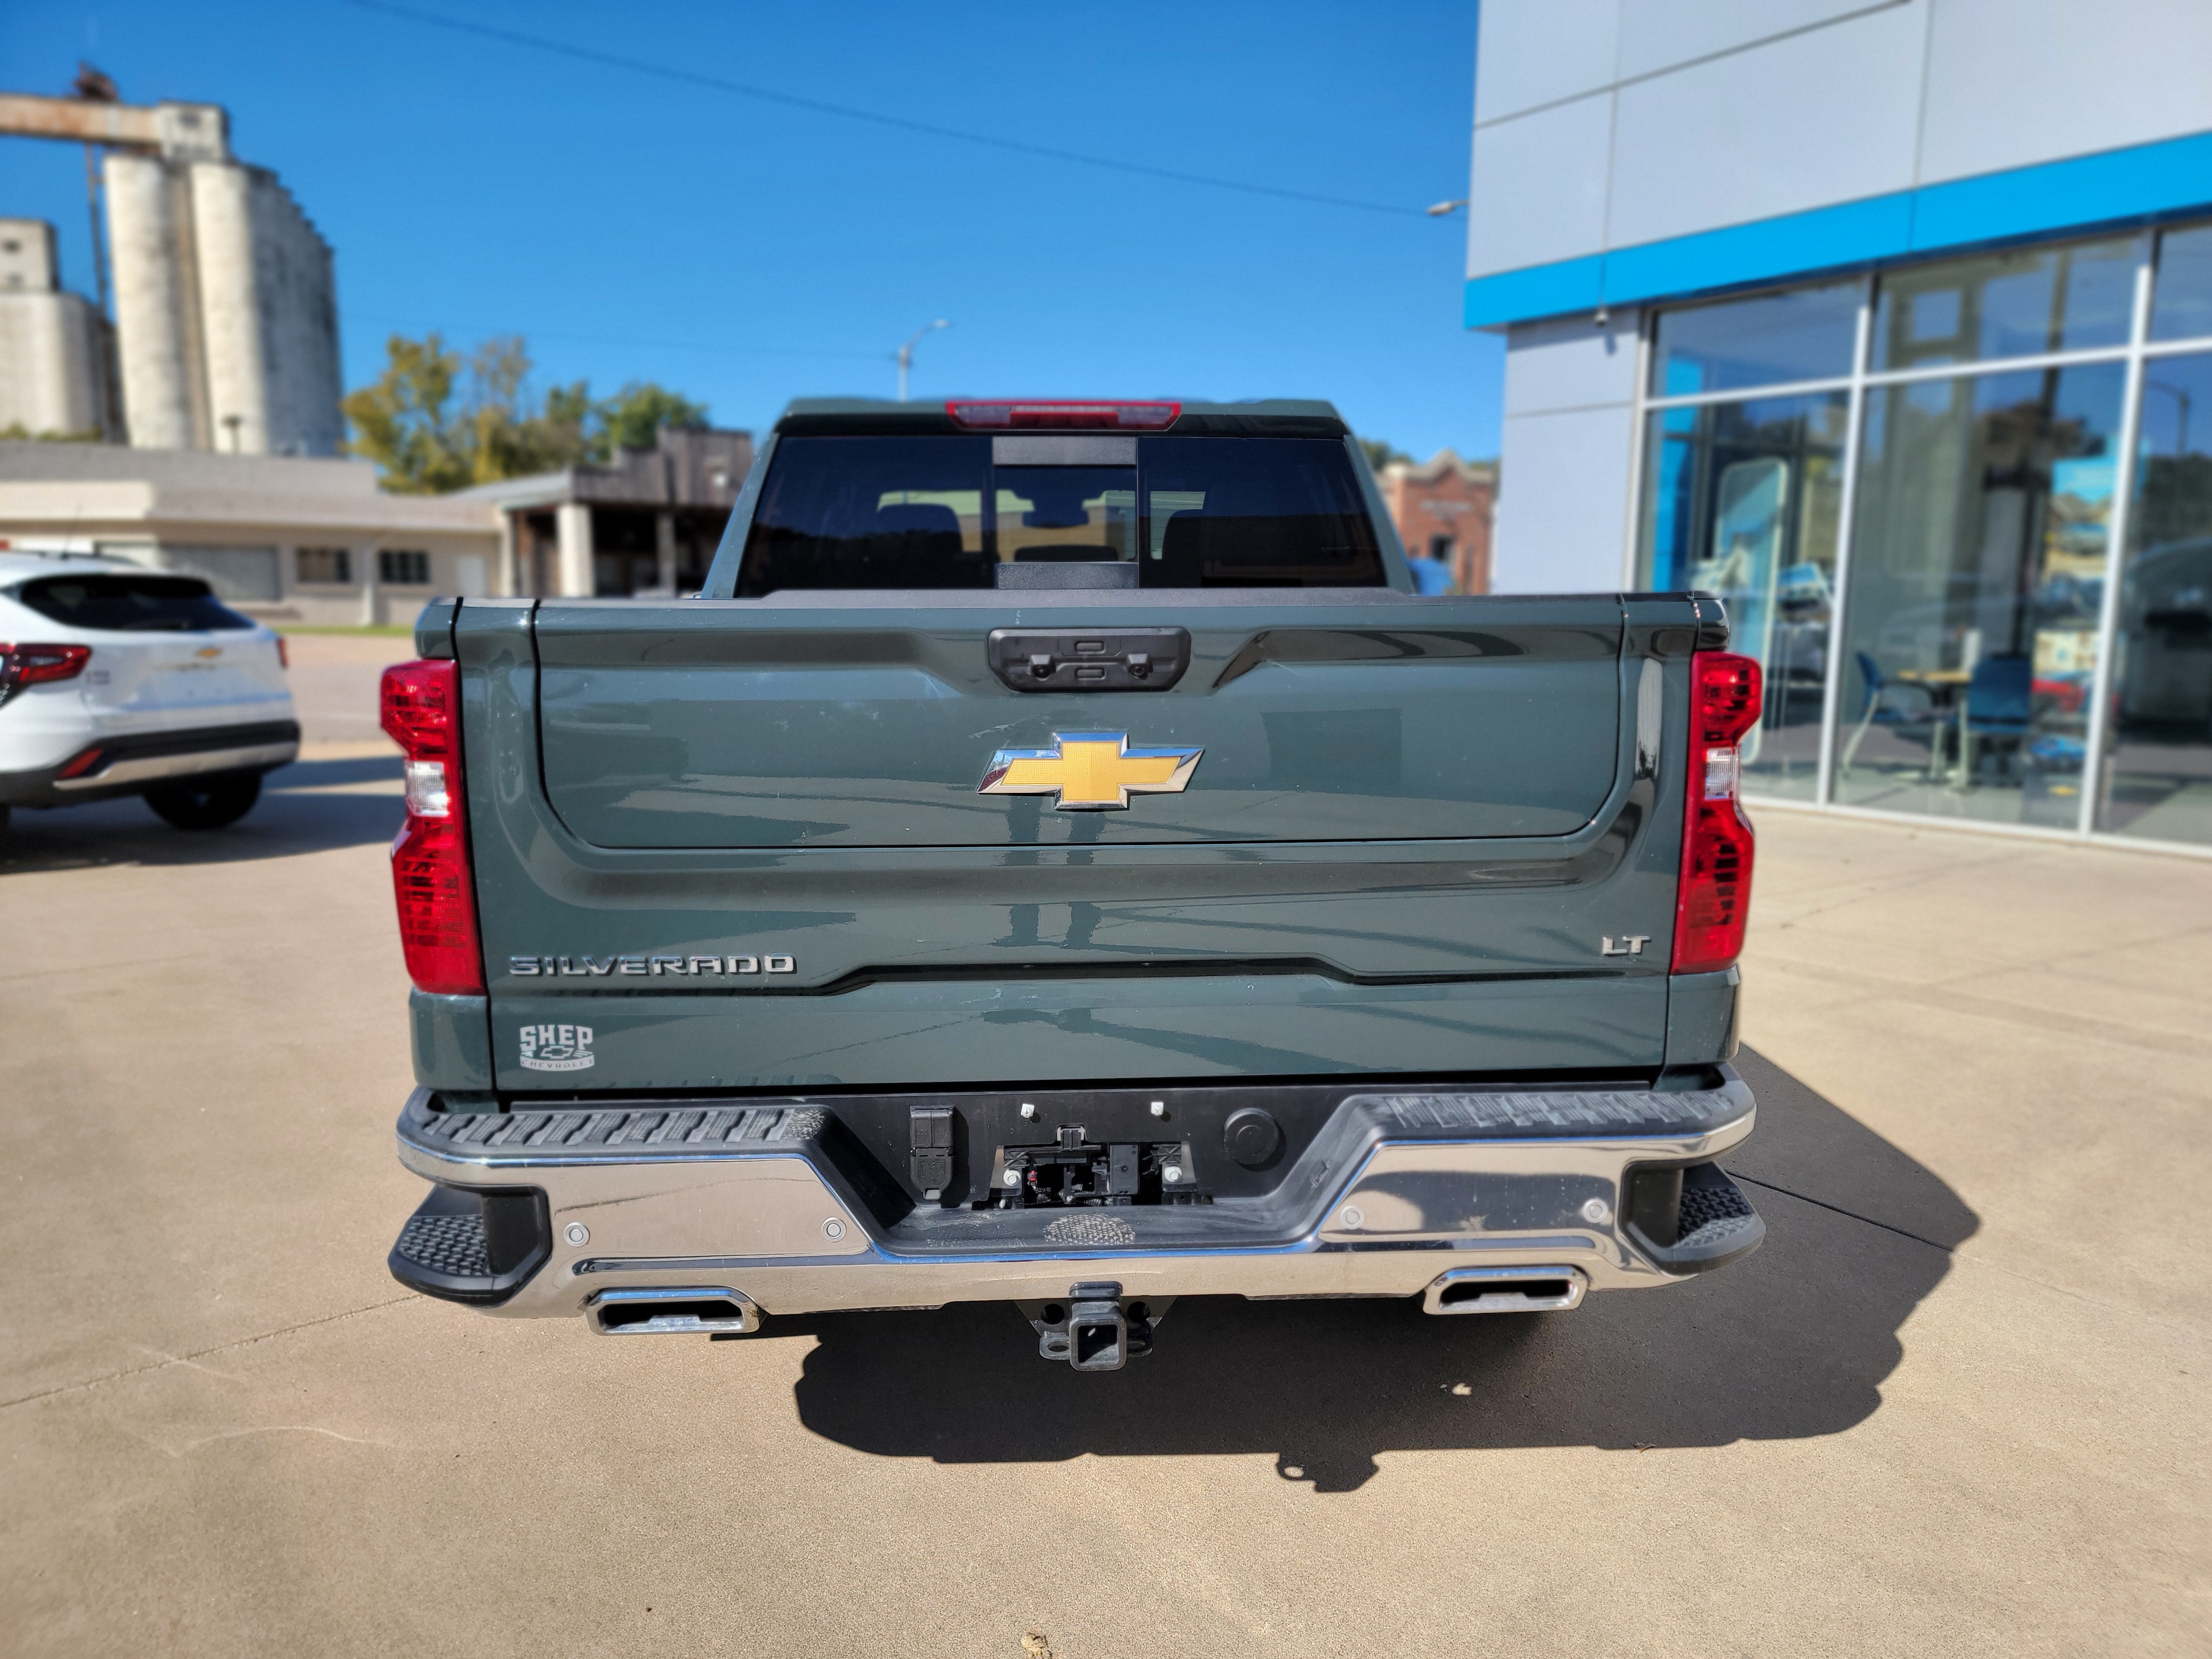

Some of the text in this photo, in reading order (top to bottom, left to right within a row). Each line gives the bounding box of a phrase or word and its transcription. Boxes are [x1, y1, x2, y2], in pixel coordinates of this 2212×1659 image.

[1603, 935, 1651, 955] LT
[509, 954, 796, 975] SILVERADO
[519, 1024, 593, 1051] SHEP
[521, 1059, 593, 1068] CHEVROLET
